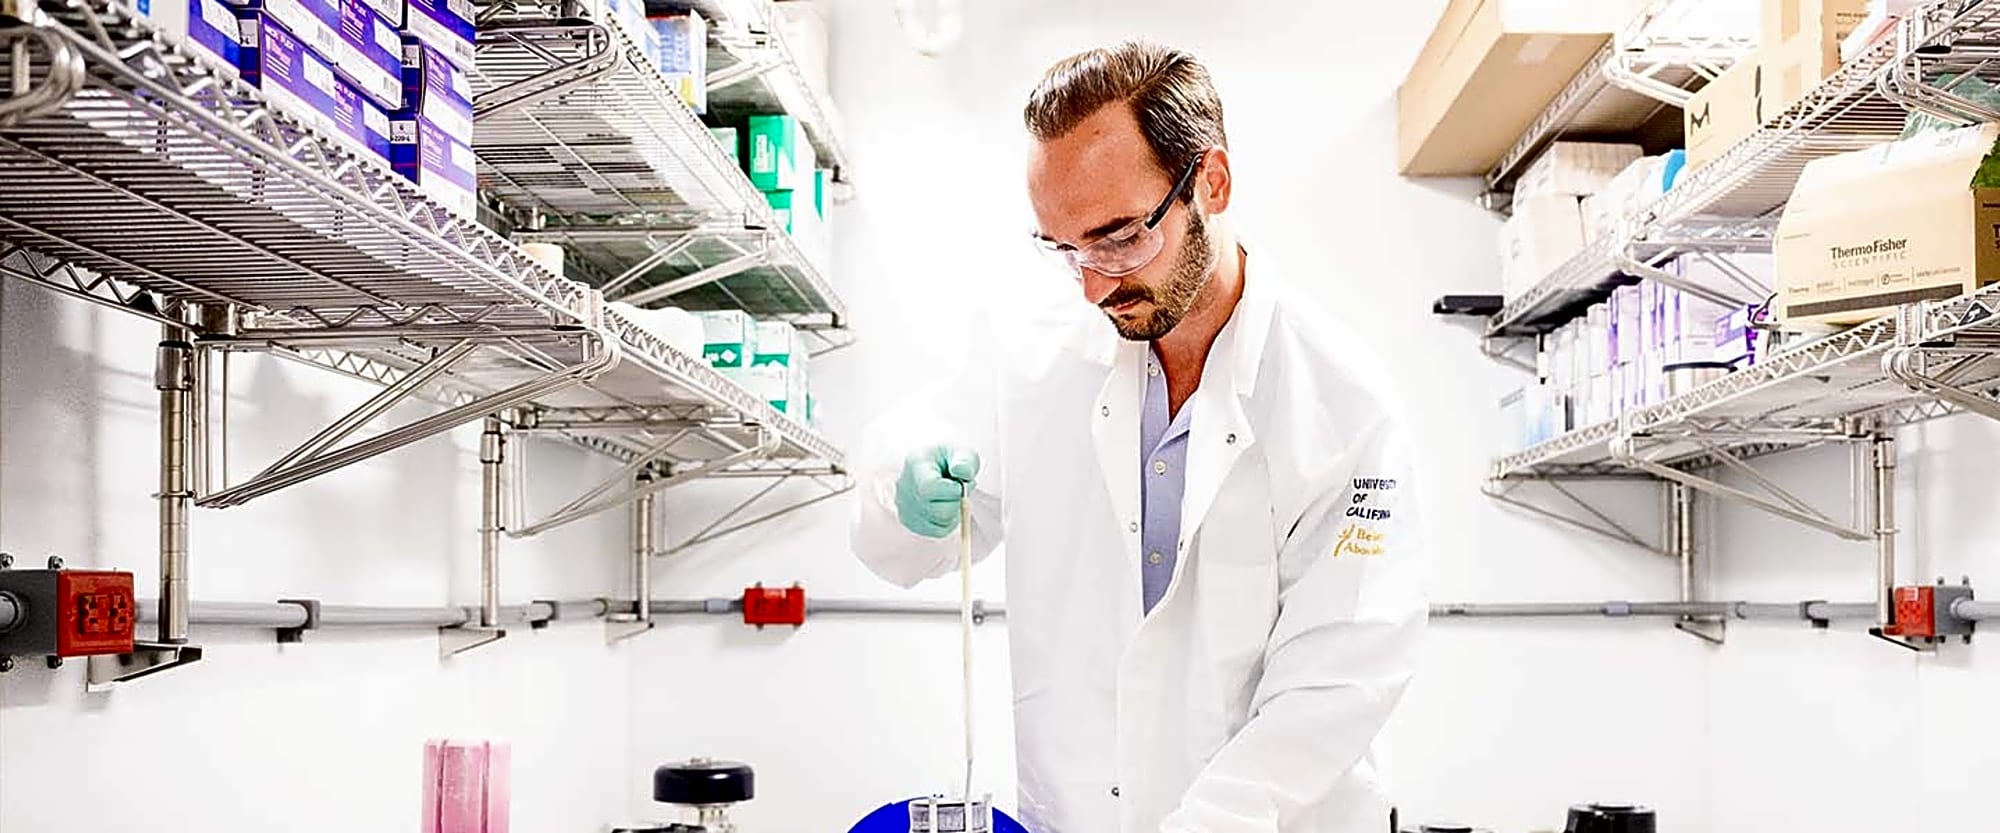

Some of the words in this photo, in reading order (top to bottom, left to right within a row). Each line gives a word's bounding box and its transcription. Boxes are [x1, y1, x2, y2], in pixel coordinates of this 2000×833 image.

[1690, 101, 1710, 136] M
[1352, 492, 1368, 504] OF
[1346, 506, 1391, 520] CALIF
